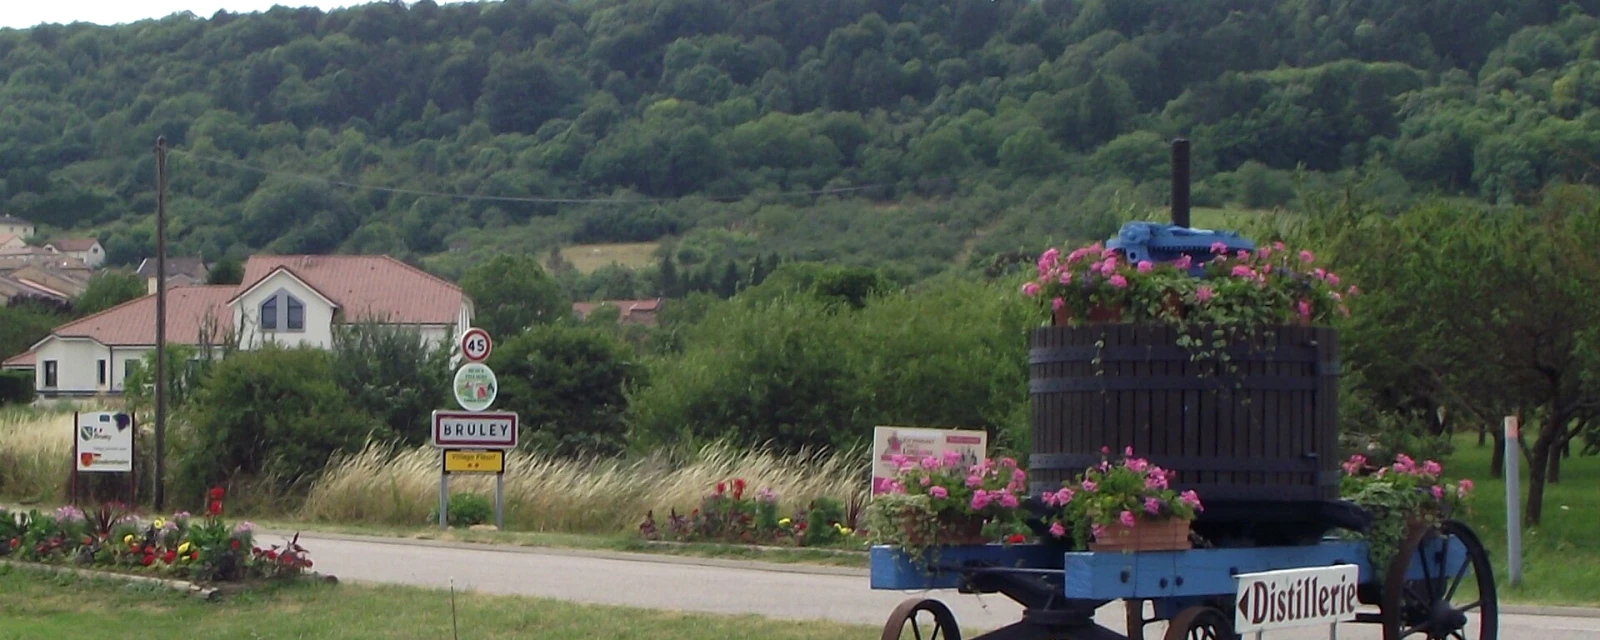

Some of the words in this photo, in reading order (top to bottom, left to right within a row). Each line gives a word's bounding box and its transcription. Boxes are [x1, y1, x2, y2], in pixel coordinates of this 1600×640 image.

[468, 339, 485, 352] 45
[444, 423, 508, 437] BRULEY
[1252, 574, 1356, 625] Distillerie
